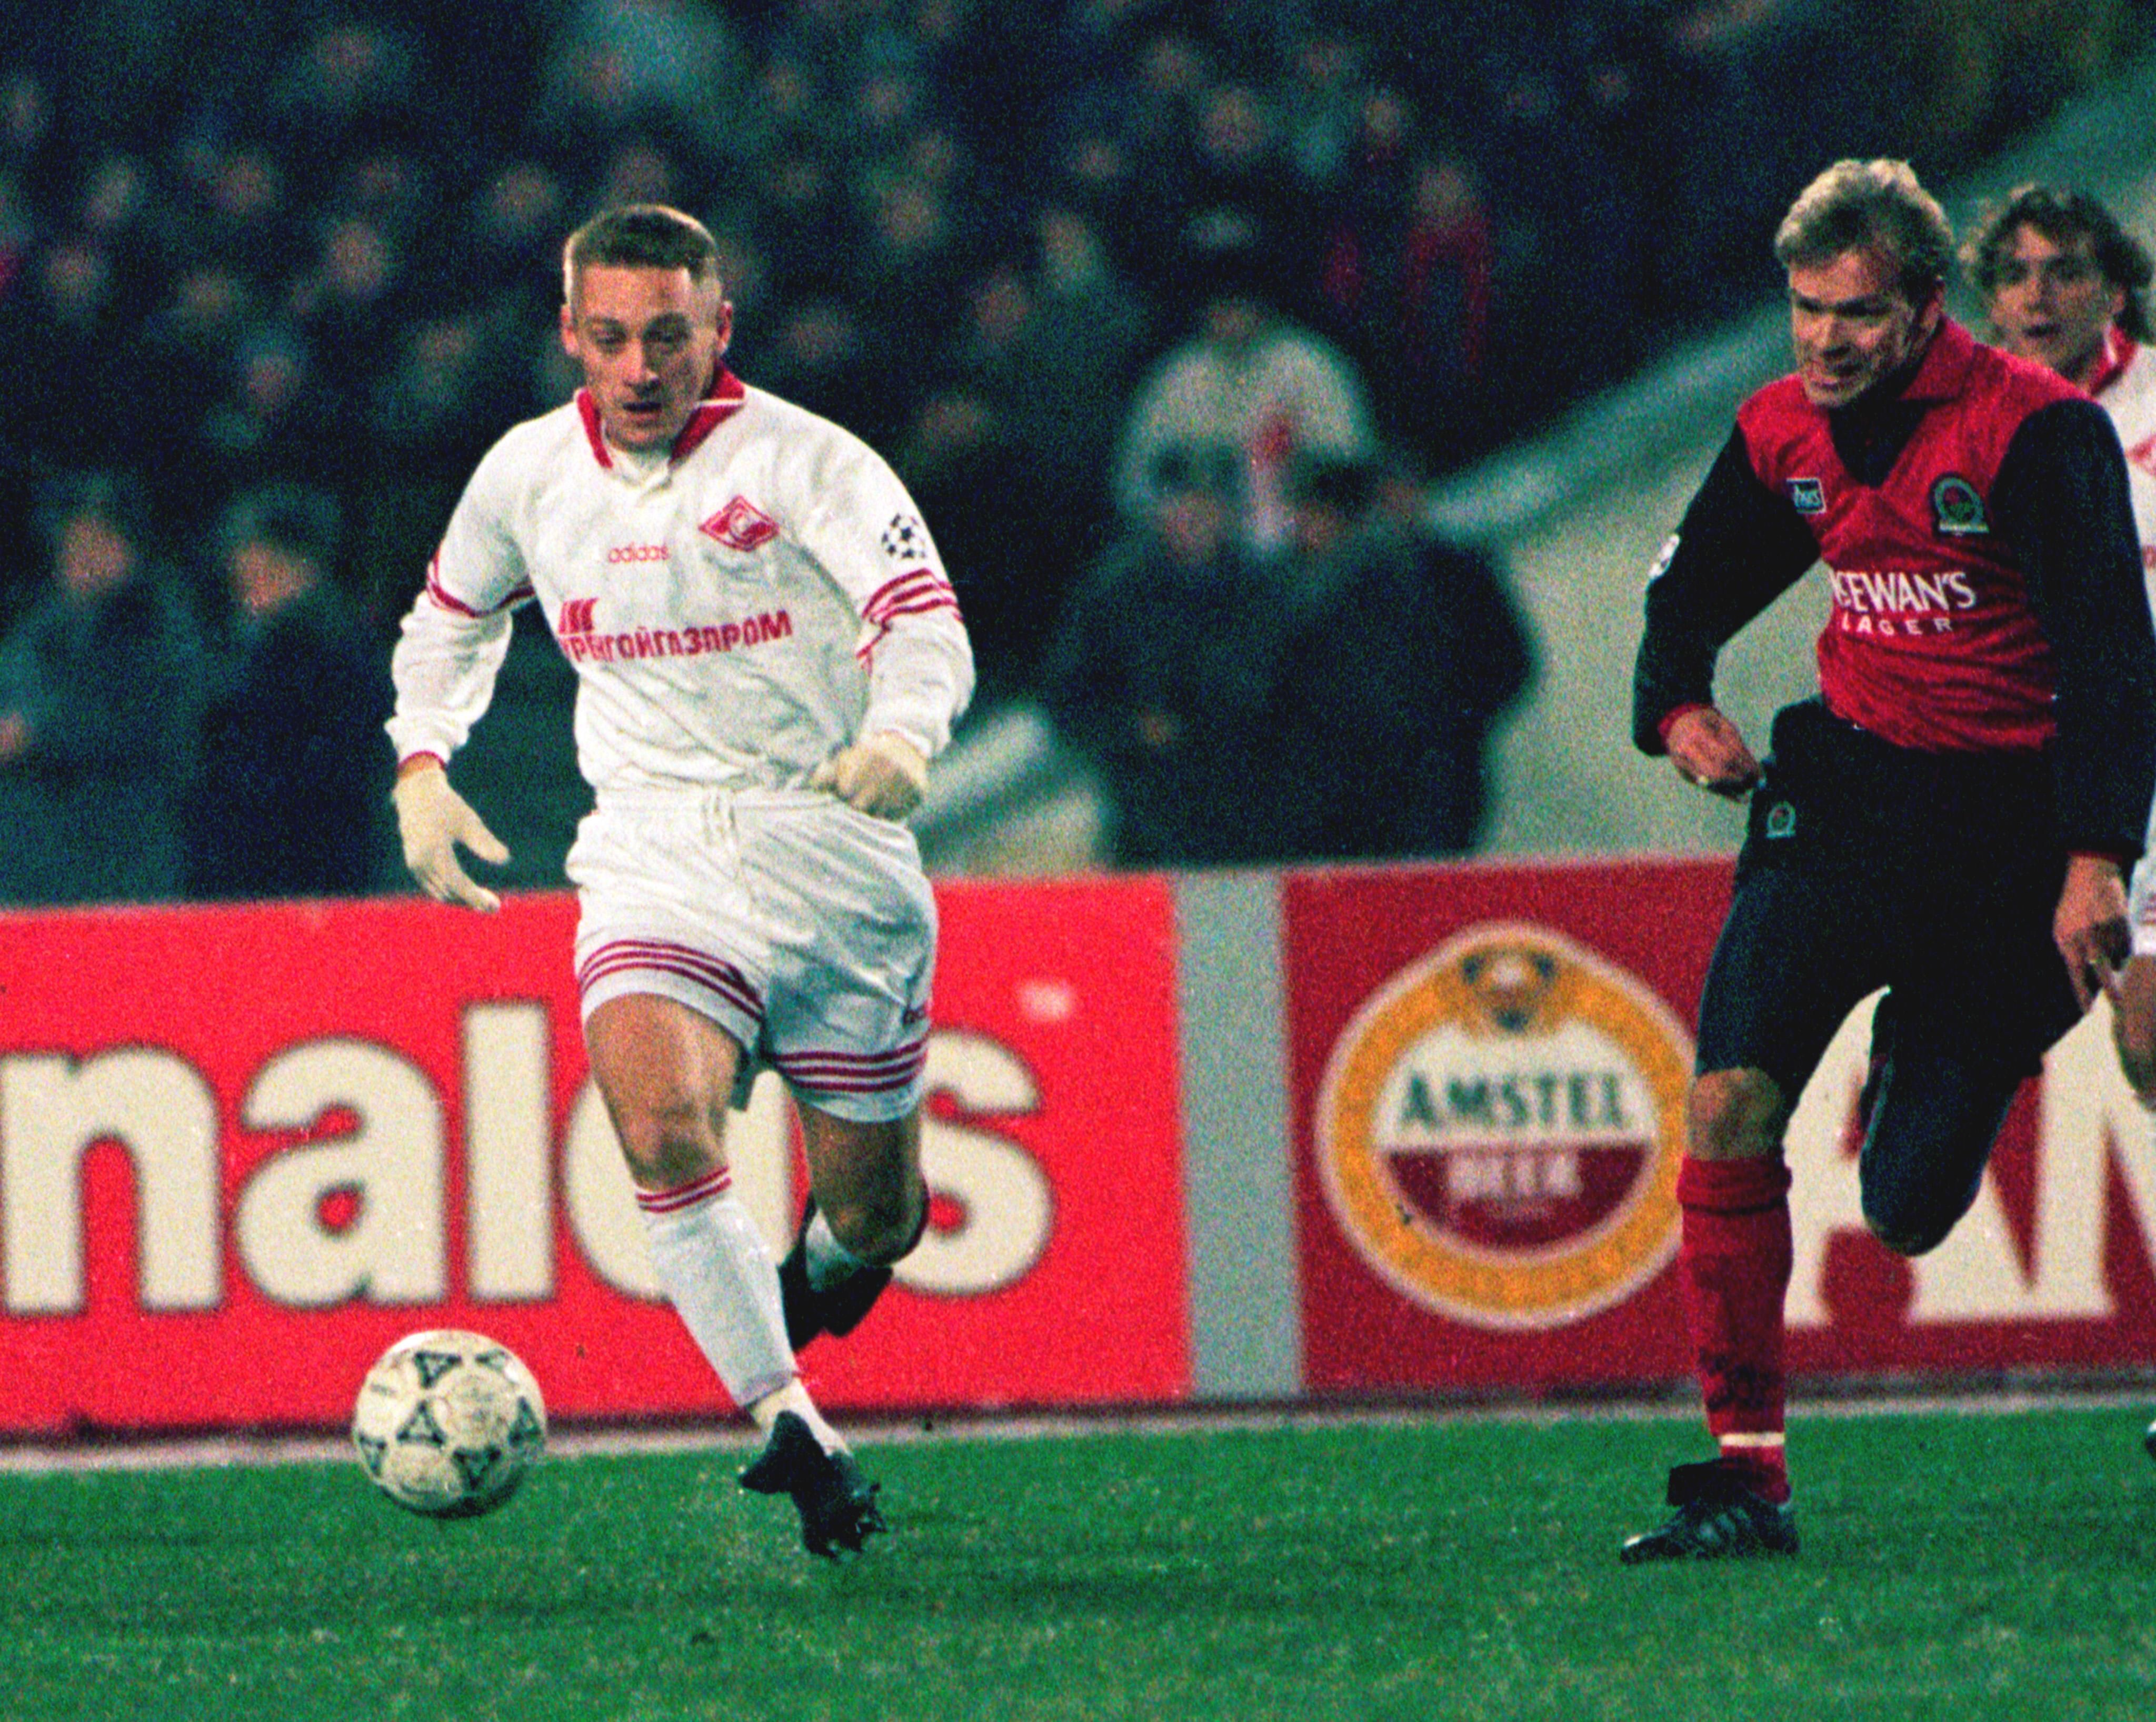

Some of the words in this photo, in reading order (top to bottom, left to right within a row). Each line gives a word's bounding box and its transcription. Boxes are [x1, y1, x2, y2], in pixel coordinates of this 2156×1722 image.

[608, 541, 668, 563] adidas
[1842, 612, 1952, 635] LAGER
[1399, 1071, 1626, 1130] AMSTEL
